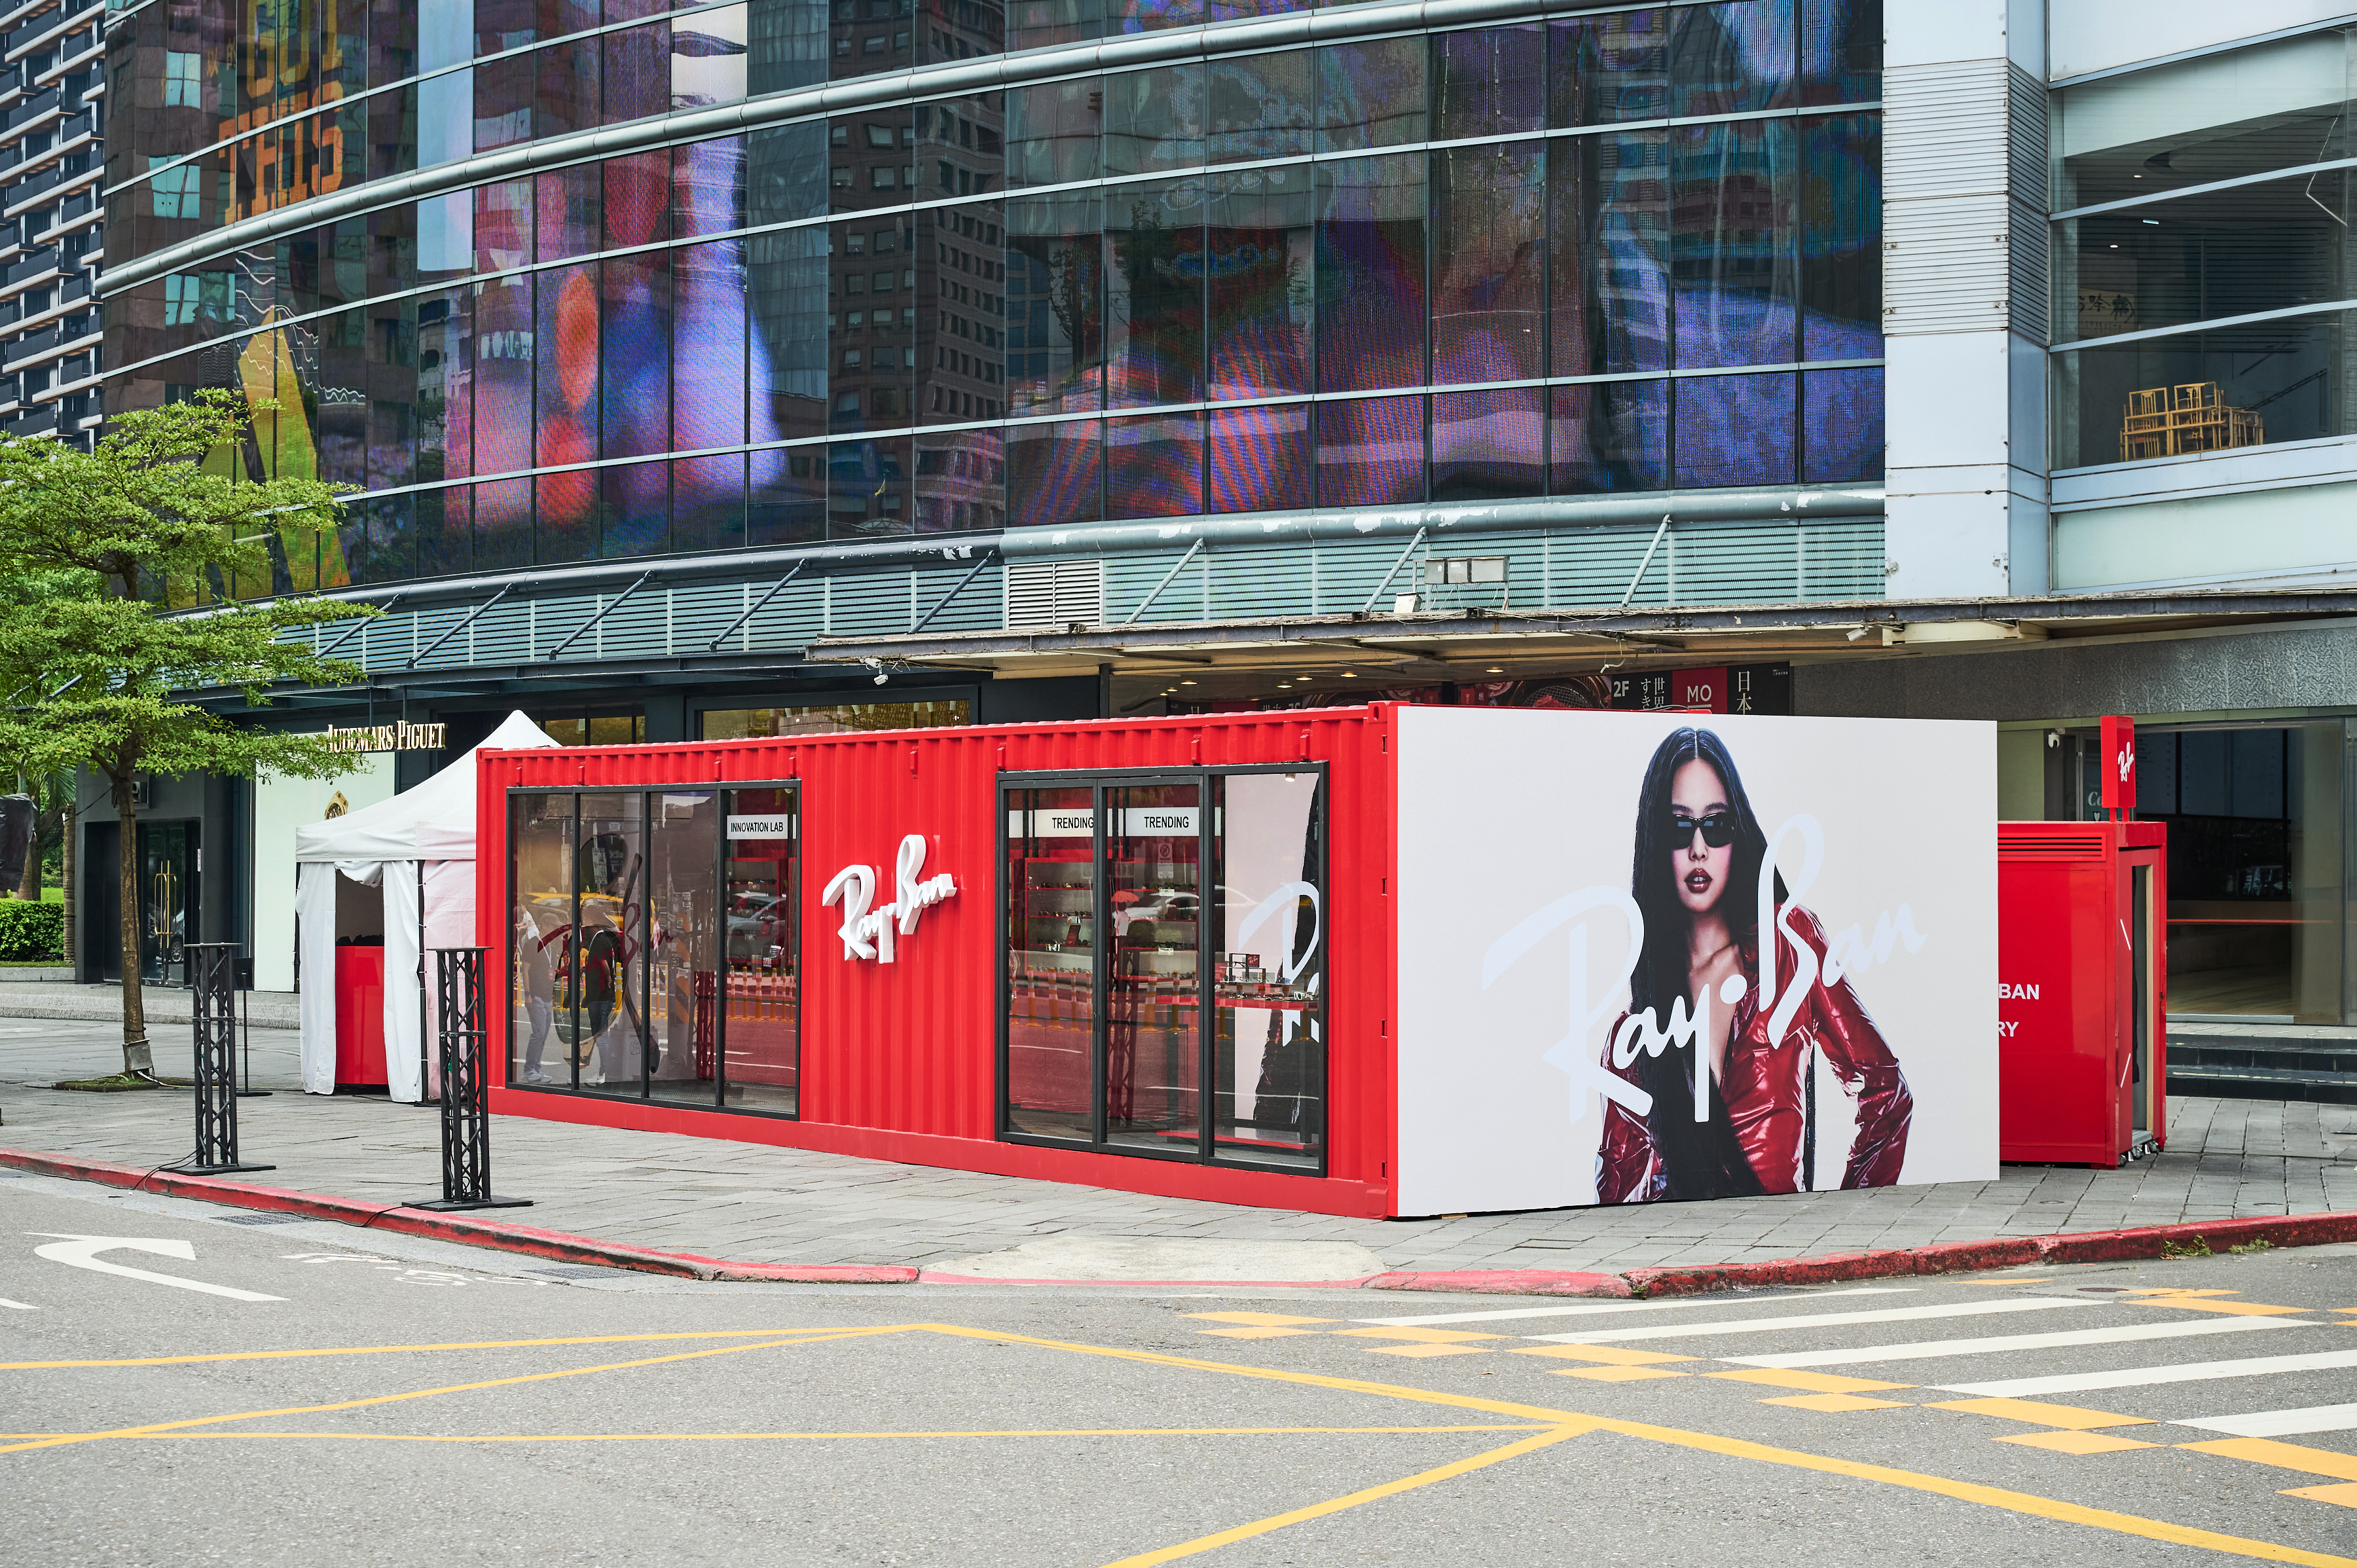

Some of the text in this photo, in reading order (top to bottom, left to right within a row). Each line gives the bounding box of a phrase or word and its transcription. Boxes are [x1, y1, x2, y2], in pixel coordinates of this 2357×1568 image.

[1613, 681, 1629, 697] 2F
[1687, 685, 1711, 702] MO
[397, 720, 445, 750] PIGUET
[731, 822, 784, 832] INNOVATION LAB
[1052, 817, 1093, 829] TRENDING
[1144, 816, 1189, 828] TRENDING
[1998, 983, 2039, 1000] BAN
